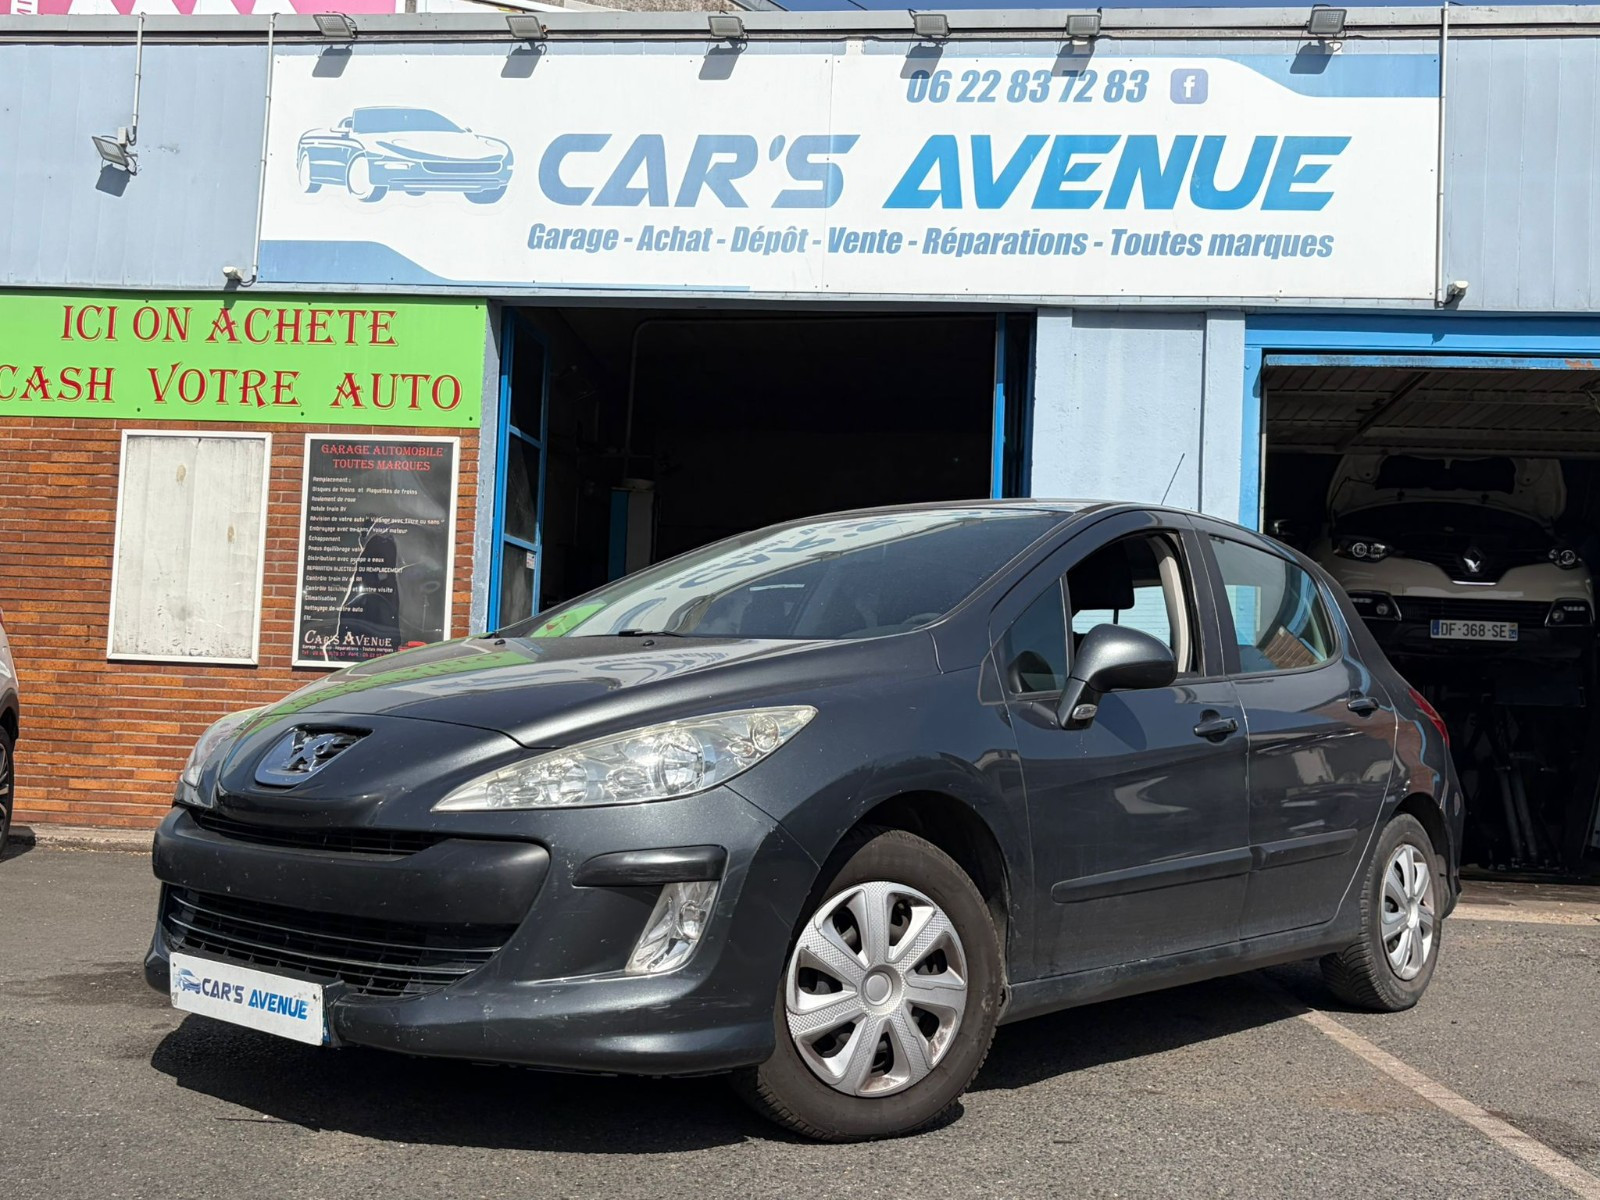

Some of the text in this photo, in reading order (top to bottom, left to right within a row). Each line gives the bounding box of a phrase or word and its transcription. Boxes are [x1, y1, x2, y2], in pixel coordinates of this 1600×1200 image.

[906, 69, 1150, 103] 06 22 83 72 83
[538, 133, 1353, 211] CAR'S AVENUE
[527, 223, 619, 252] Garage
[636, 225, 712, 252] Achat
[730, 225, 809, 256] Dépôt
[828, 226, 903, 254] Vente
[922, 226, 1088, 258] Réparations
[1110, 228, 1201, 257] Toutes
[1207, 234, 1335, 260] marques
[60, 304, 399, 346] ICI ON ACHETE
[0, 361, 463, 411] CASH VOTRE AUTO
[321, 444, 443, 457] GARAGE AUTOMOBILE
[333, 459, 431, 472] TOUTES MARQUES
[202, 978, 310, 1020] CAR'S AVENUE
